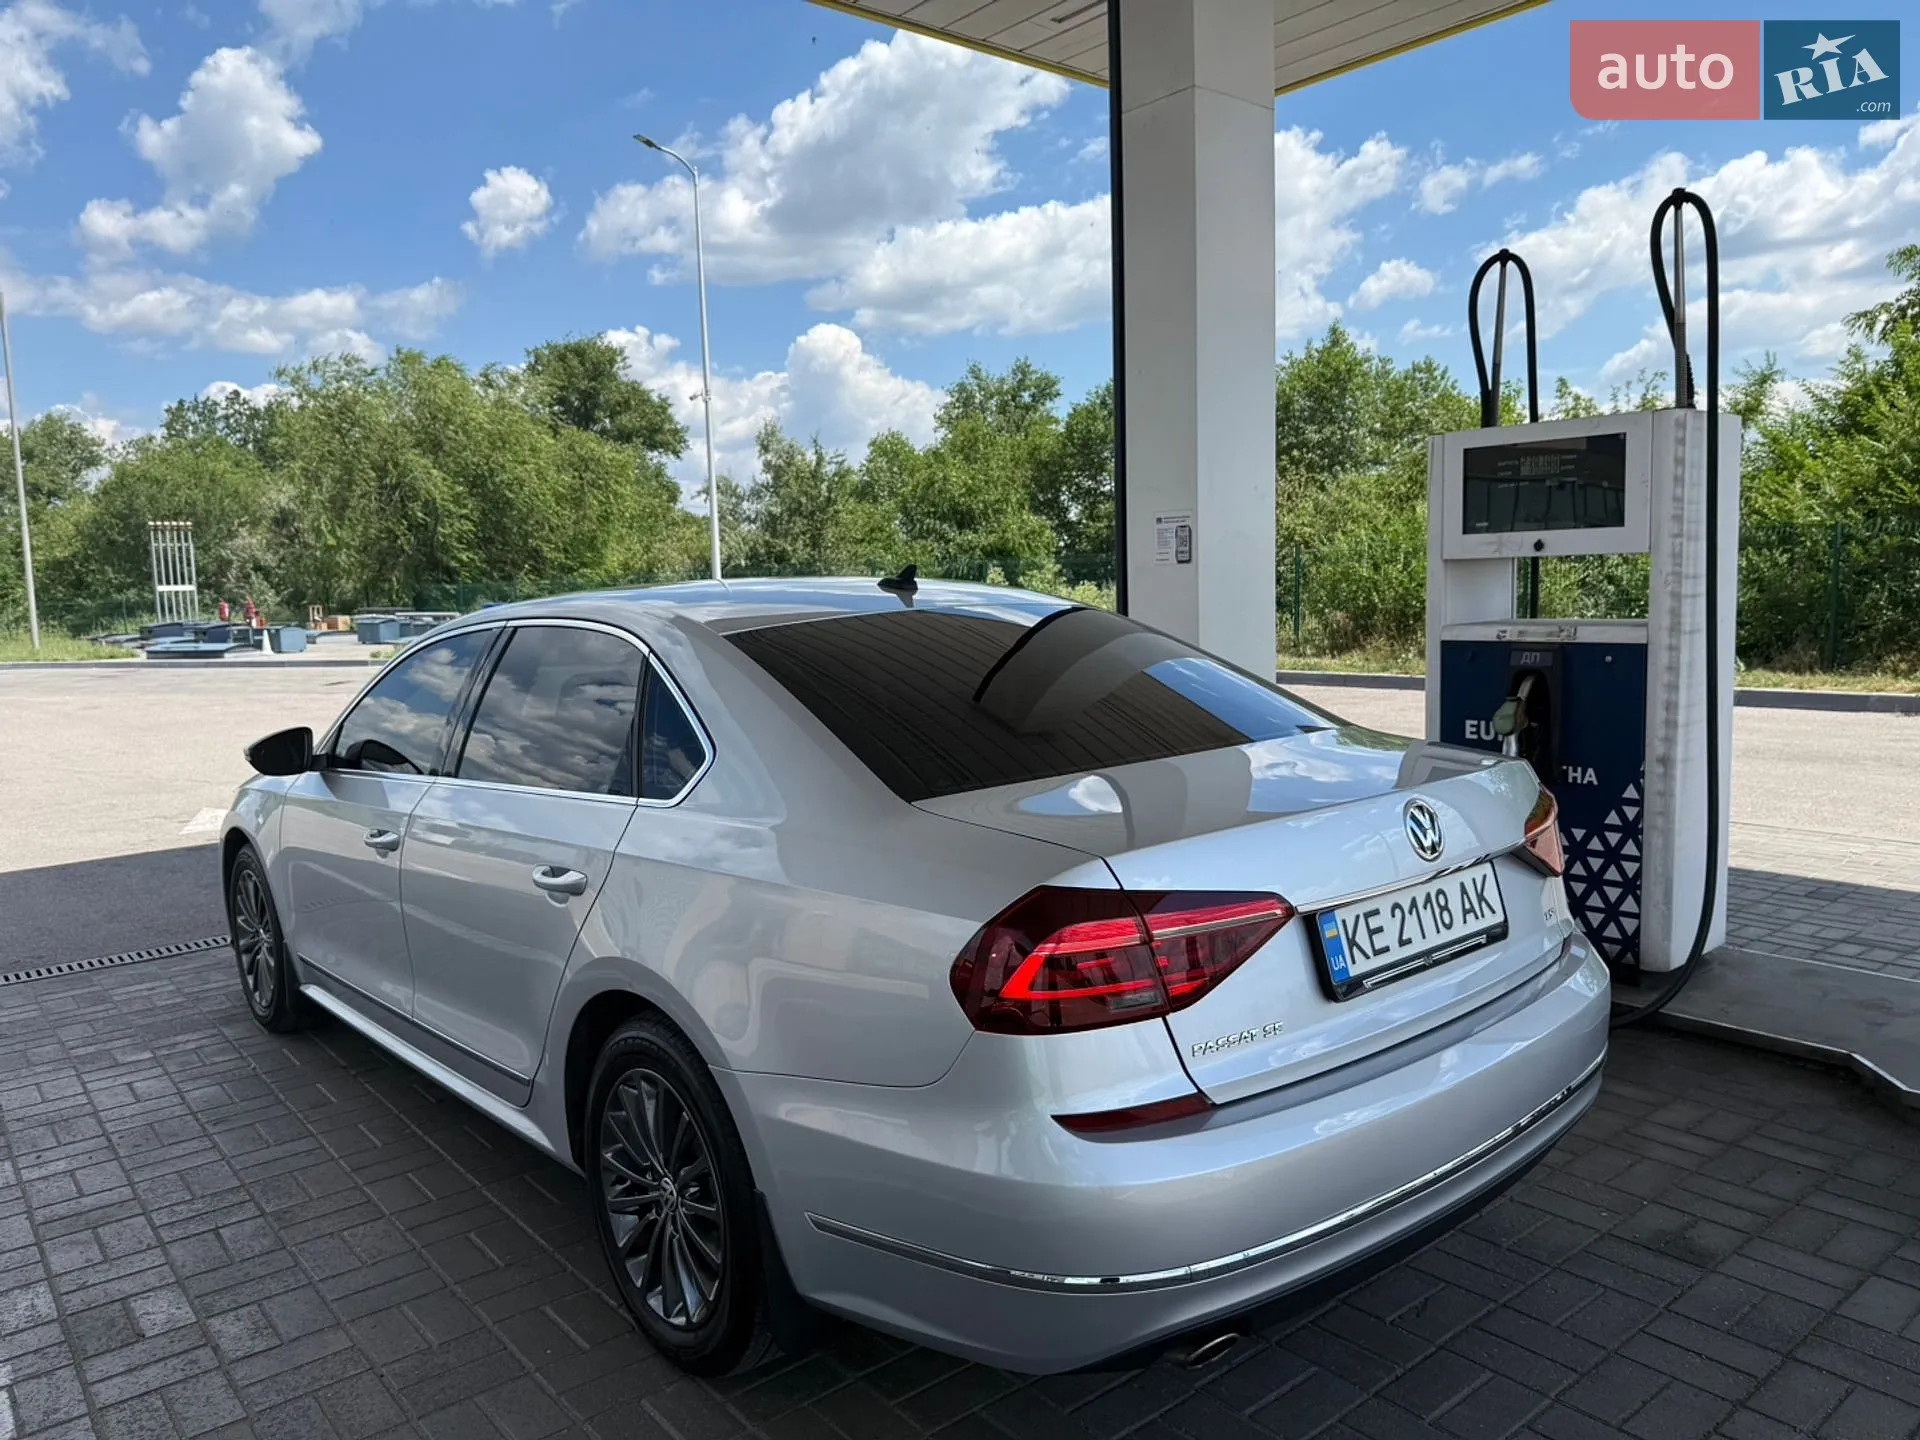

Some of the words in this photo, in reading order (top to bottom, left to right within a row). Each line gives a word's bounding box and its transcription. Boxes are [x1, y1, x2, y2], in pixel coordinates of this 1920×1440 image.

[1520, 651, 1541, 665] ДП
[1342, 908, 1391, 965] KE
[1391, 887, 1454, 948] 2118
[1459, 872, 1497, 925] AK
[1331, 955, 1347, 971] UA
[1191, 1028, 1260, 1057] PASSAT
